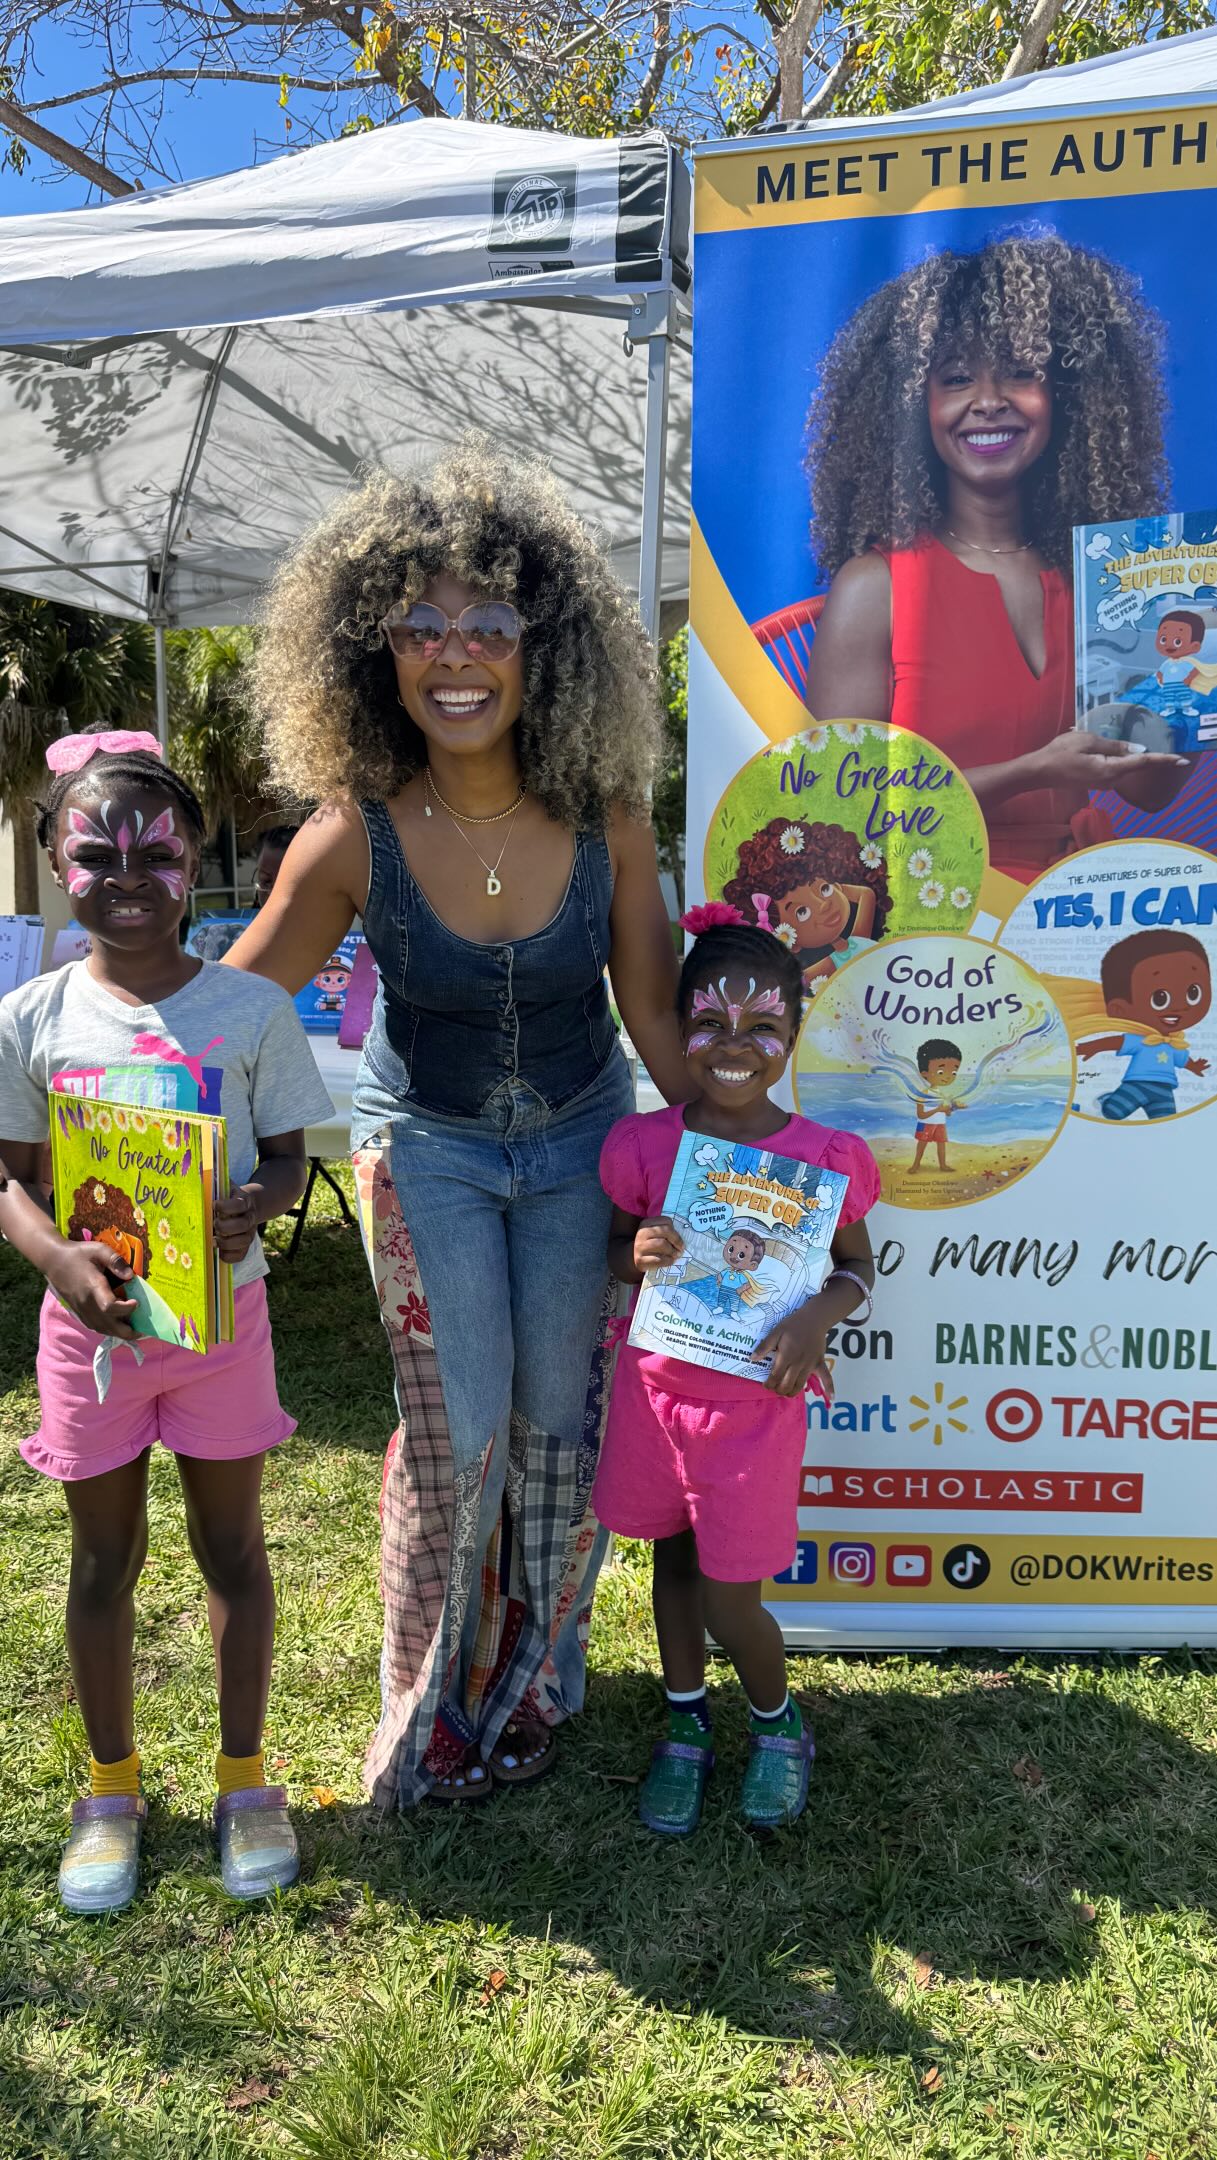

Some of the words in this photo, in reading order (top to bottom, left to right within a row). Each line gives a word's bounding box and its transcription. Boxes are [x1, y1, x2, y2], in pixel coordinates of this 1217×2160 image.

[757, 152, 899, 204] MEET
[921, 139, 1028, 187] THE
[1050, 121, 1217, 176] AUTH
[511, 179, 544, 201] ORIGINAL
[494, 267, 542, 277] Ambassador
[1104, 556, 1132, 574] THE
[1121, 563, 1186, 593] SUPER
[1103, 594, 1137, 617] NOTHING
[1110, 612, 1120, 622] TO
[1120, 602, 1138, 618] FEAR
[779, 754, 823, 795] No
[835, 751, 954, 798] Greater
[865, 793, 945, 841] Love
[487, 878, 501, 895] D
[1067, 876, 1084, 886] THE
[1087, 870, 1138, 883] ADVENTURES
[1140, 868, 1152, 879] OF
[1154, 866, 1182, 877] SUPER
[1183, 864, 1203, 875] OBI
[1034, 892, 1104, 930] YES,
[1110, 890, 1126, 926] I
[886, 955, 954, 989] God
[964, 954, 996, 987] of
[864, 985, 1023, 1026] Wonders
[90, 1133, 110, 1162] No
[118, 1136, 180, 1176] Greater
[135, 1170, 174, 1209] Love
[706, 1171, 731, 1182] THE
[731, 1174, 805, 1203] ADVENTURES
[805, 1196, 821, 1210] OF
[695, 1205, 727, 1217] NOTHING
[699, 1217, 708, 1225] TO
[709, 1214, 726, 1224] FEAR
[715, 1186, 772, 1214] SUPER
[772, 1200, 804, 1228] OBI
[873, 1239, 905, 1276] o
[929, 1234, 1079, 1287] many
[1102, 1237, 1217, 1285] mor
[654, 1310, 703, 1334] Coloring
[705, 1325, 715, 1335] &
[716, 1328, 758, 1349] Activity
[663, 1328, 689, 1340] INCLUDES
[689, 1335, 715, 1347] COLORING
[825, 1327, 893, 1360] zon
[688, 1342, 711, 1353] WRITING
[805, 1394, 898, 1433] mart
[1051, 1397, 1217, 1441] TARGE
[844, 1476, 1134, 1502] SCHOLASTIC
[1010, 1554, 1214, 1587] @DOKWrites
